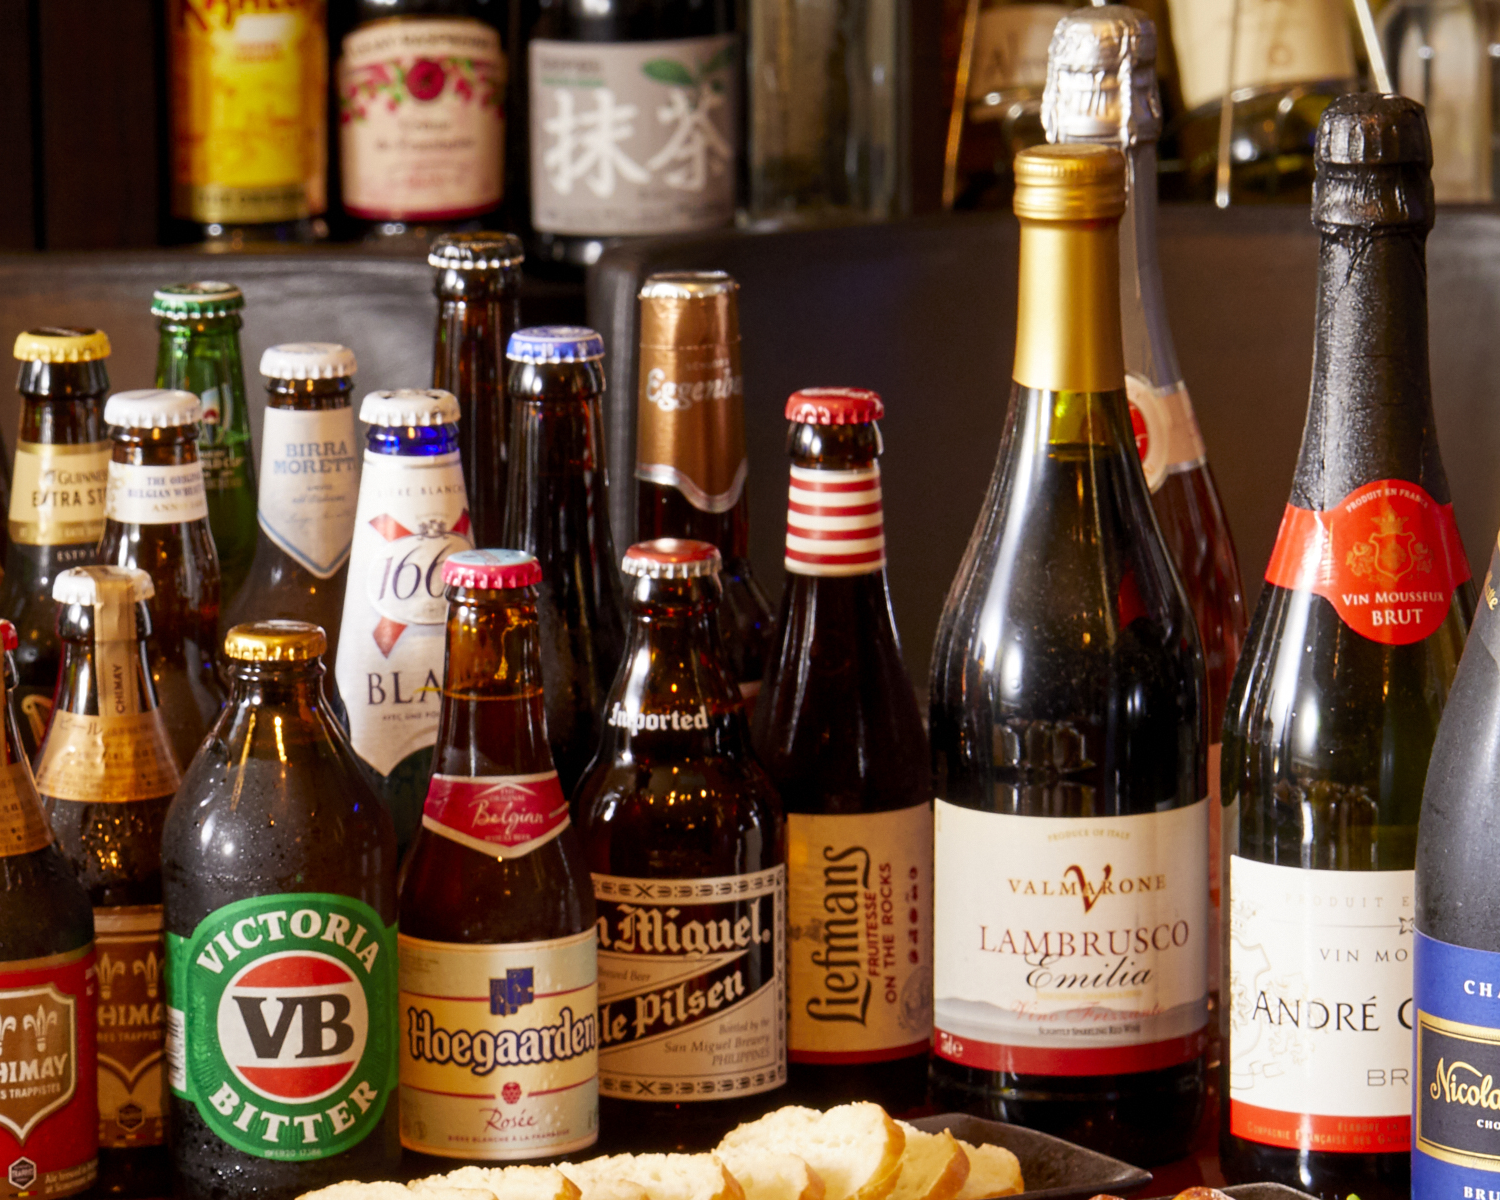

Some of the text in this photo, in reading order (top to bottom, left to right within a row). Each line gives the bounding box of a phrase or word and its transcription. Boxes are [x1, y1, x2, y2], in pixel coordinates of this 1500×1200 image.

[541, 87, 732, 197] 抹茶
[286, 440, 348, 459] BIRRA
[1345, 490, 1383, 514] PRODUIT
[1371, 608, 1424, 627] BRUT
[115, 663, 126, 714] CHIMAY
[366, 669, 444, 705] BLA
[608, 701, 709, 737] Imported
[468, 799, 544, 835] Belgian
[1007, 873, 1168, 897] VALMARONE
[196, 908, 380, 974] VICTORIA
[864, 891, 881, 979] FRUITESSE
[878, 862, 898, 1004] ON THE ROCKS
[978, 919, 1190, 958] LAMBRUSCO
[1024, 951, 1154, 990] Emilia
[1319, 947, 1360, 963] VIN
[232, 993, 355, 1060] VB
[1252, 990, 1381, 1033] ANDRÉ
[408, 1006, 597, 1077] Hoegaarden
[663, 1042, 687, 1054] San
[690, 1039, 732, 1056] Miguel
[9, 1082, 62, 1100] TRAPPISTES
[207, 1080, 378, 1144] BITTER
[478, 1106, 539, 1133] Rosée
